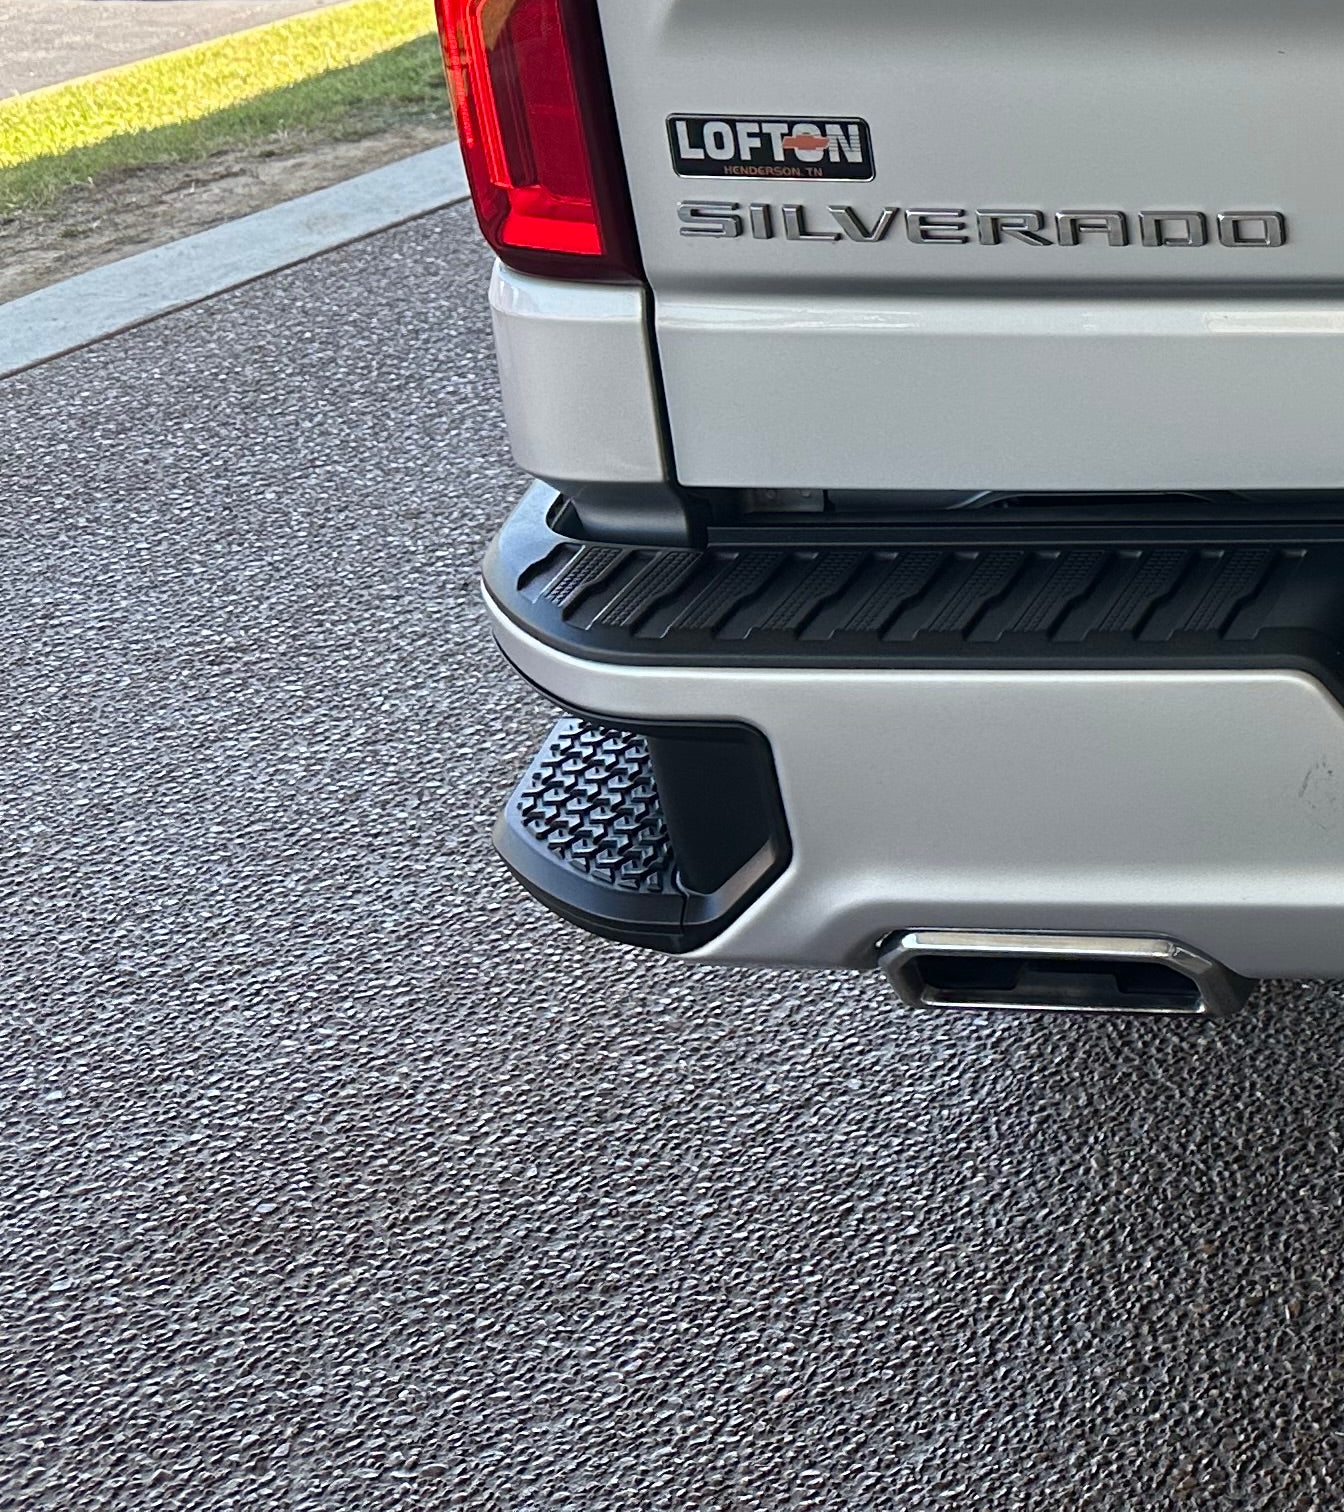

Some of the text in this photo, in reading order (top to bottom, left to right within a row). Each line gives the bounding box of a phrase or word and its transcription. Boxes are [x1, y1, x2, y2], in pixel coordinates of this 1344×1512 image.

[675, 120, 864, 163] LOFTON
[807, 167, 823, 177] TN
[676, 200, 1288, 248] SILVERADO
